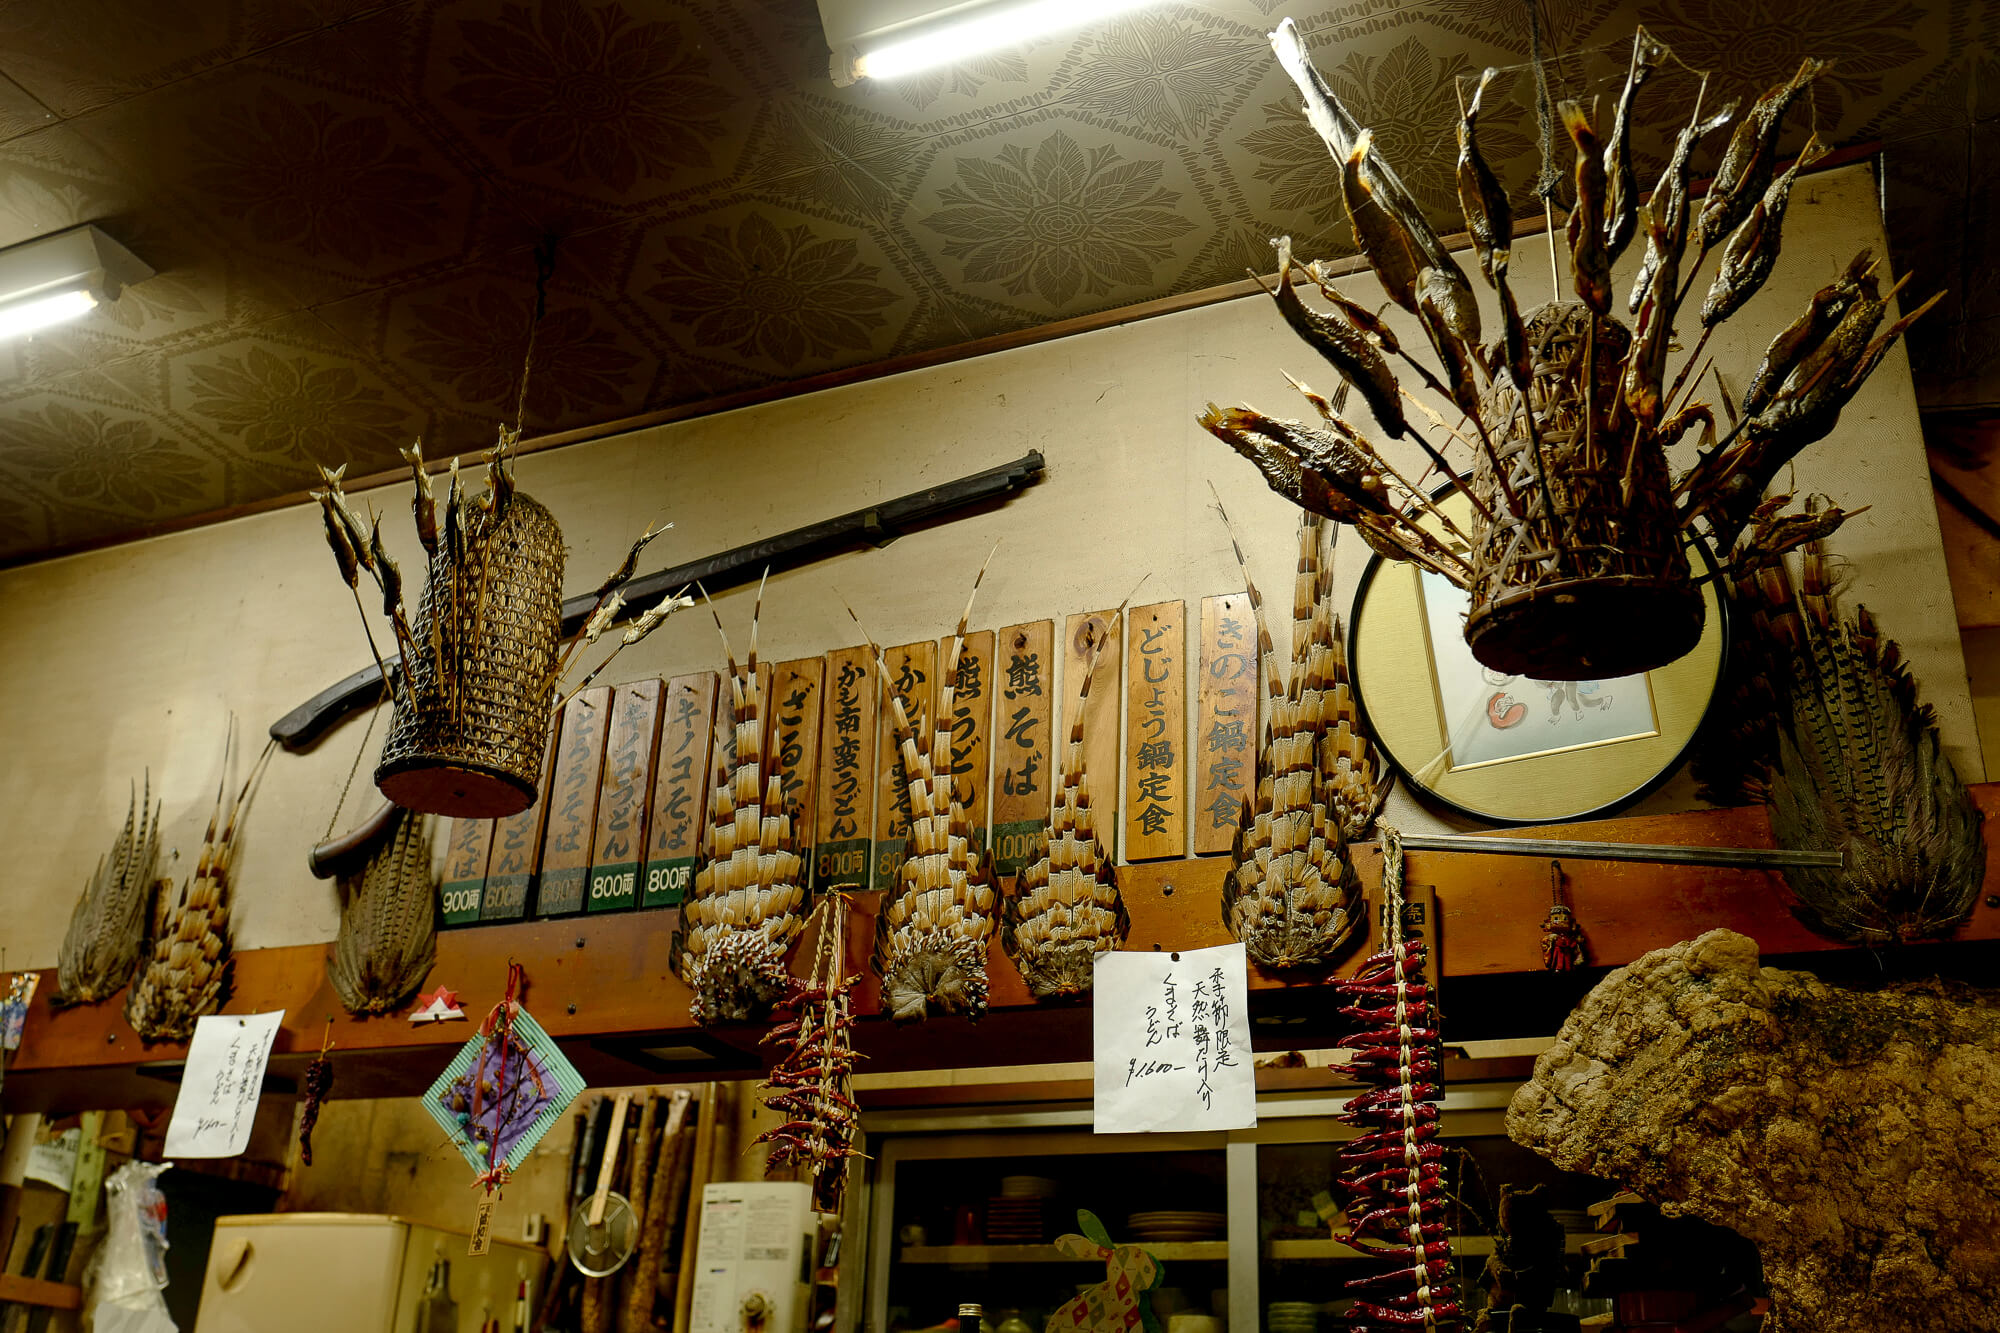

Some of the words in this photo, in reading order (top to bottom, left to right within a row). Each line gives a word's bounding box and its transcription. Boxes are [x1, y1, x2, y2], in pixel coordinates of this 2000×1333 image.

[555, 711, 595, 853] とろろそば
[659, 697, 702, 850] キノコそば
[830, 663, 866, 840] かも南蛮うどん
[1003, 653, 1043, 796] 熊そば
[1134, 624, 1175, 836] どじょう鍋定食
[1204, 617, 1249, 830] きのこ鍋定食
[442, 889, 480, 914] 900両
[592, 873, 634, 899] 800両
[818, 850, 863, 878] 800両
[1145, 1006, 1163, 1047] うどん
[1163, 973, 1183, 1039] くまそば
